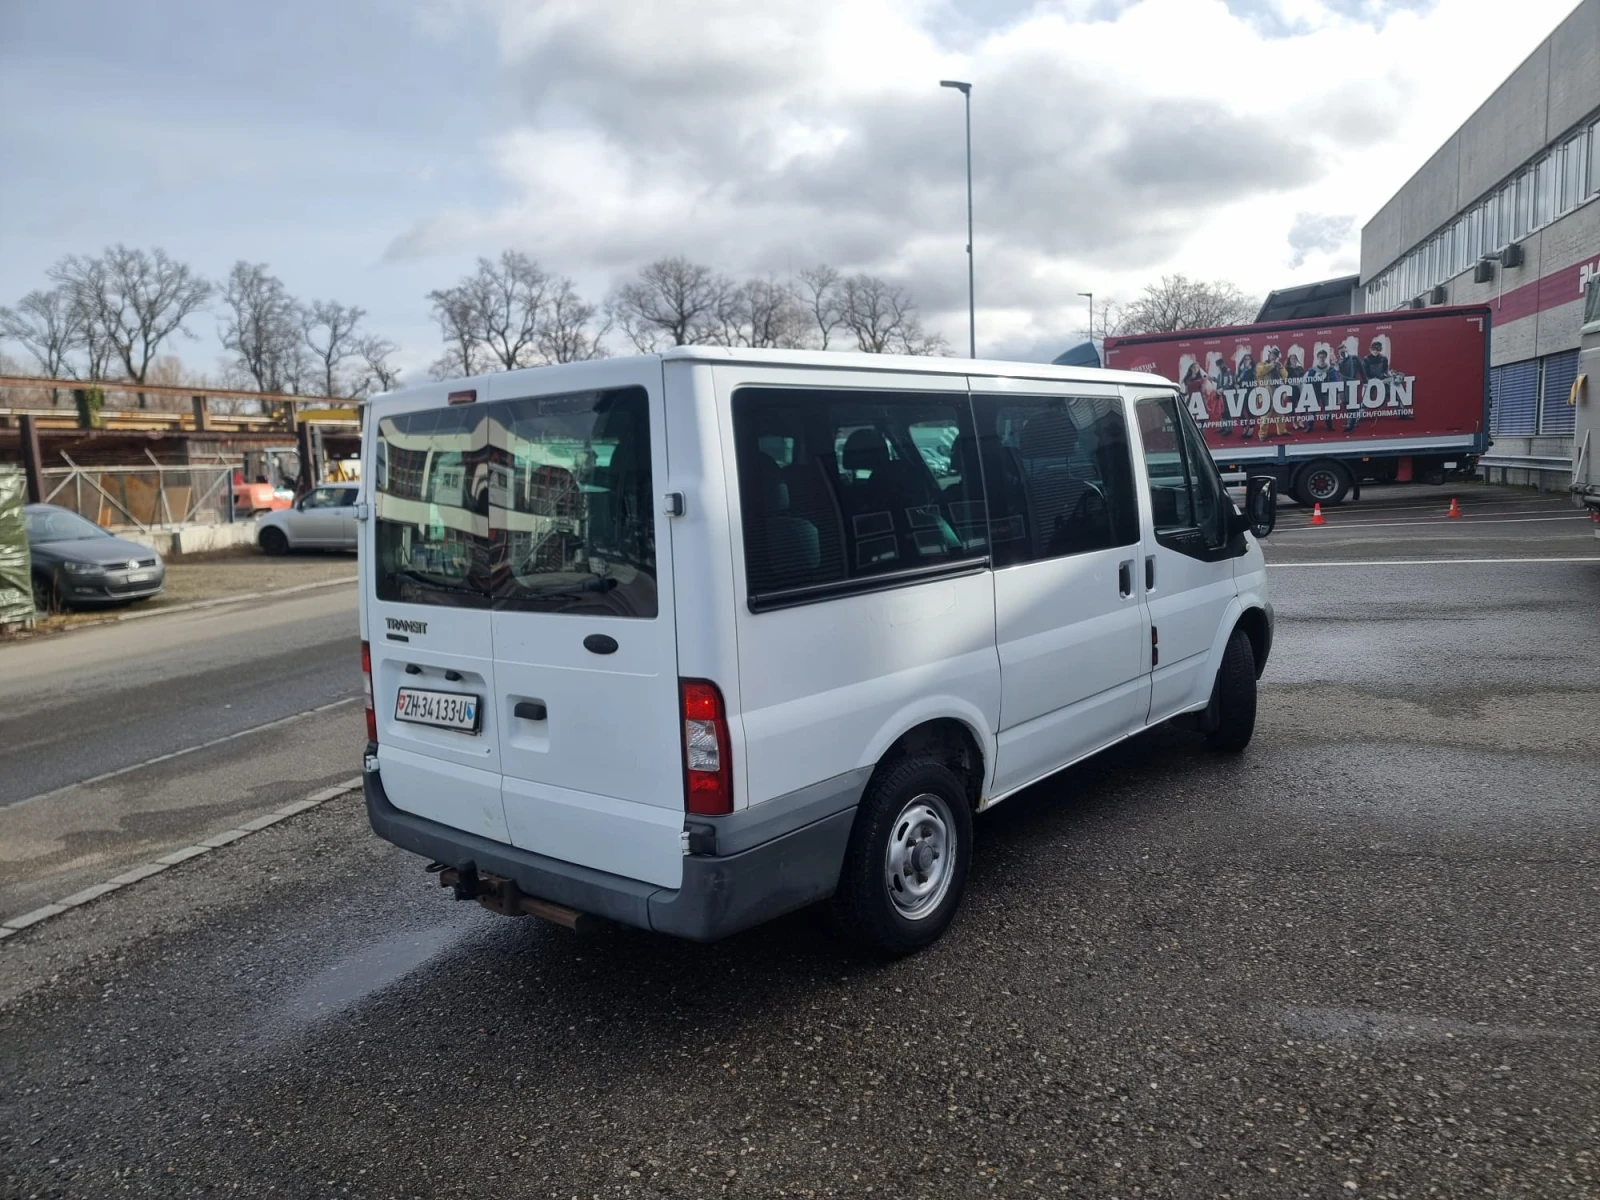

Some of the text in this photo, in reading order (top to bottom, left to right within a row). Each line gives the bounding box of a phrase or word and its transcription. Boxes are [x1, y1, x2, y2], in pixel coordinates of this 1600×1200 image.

[1223, 375, 1416, 417] VOCATION
[1281, 415, 1296, 423] FAIT
[1296, 414, 1315, 422] POUR
[385, 617, 428, 635] TRANSIT
